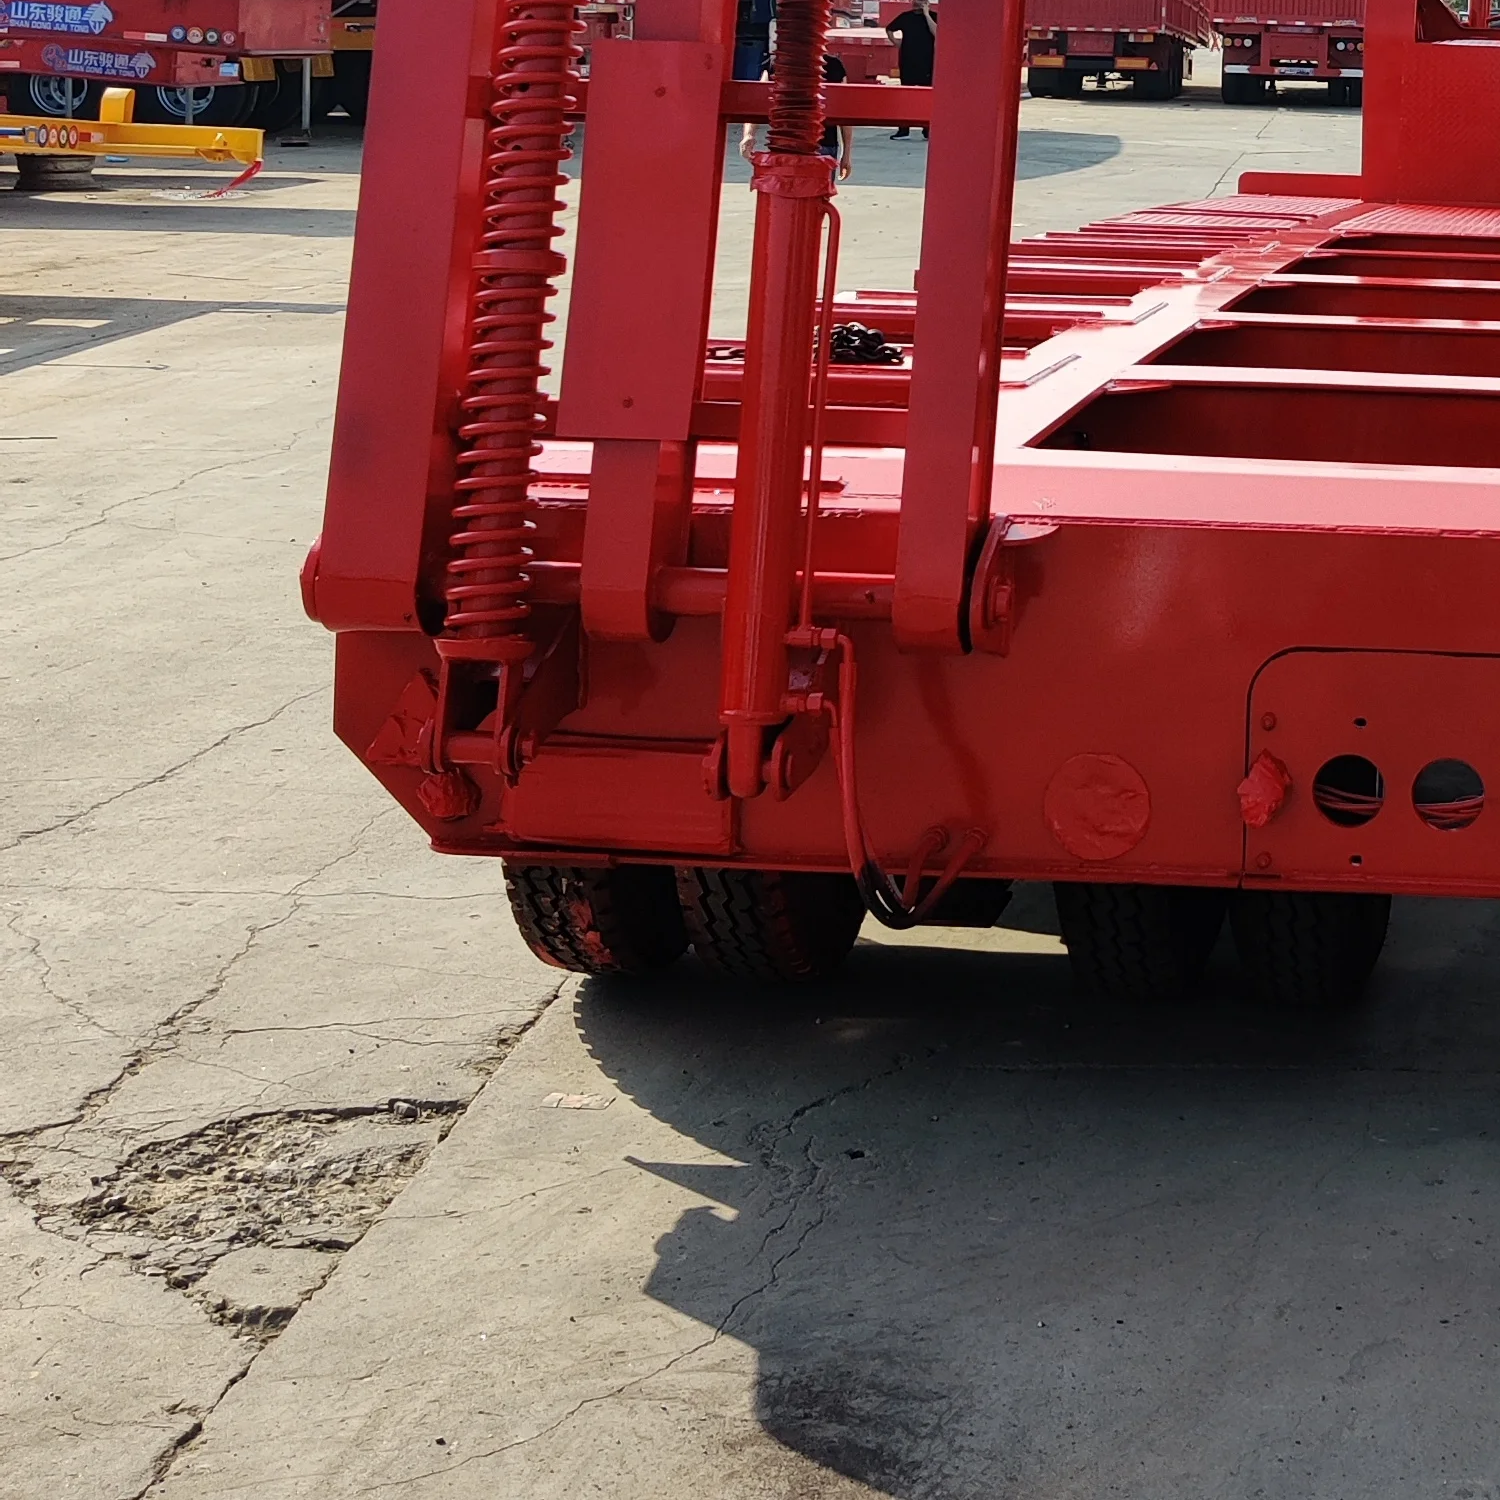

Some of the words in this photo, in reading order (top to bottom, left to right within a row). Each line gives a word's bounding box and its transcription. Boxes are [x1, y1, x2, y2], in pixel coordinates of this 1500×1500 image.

[10, 1, 82, 24] 山东骏通
[9, 20, 30, 28] SHAN
[31, 21, 52, 30] DONG
[53, 23, 68, 32] JUN
[70, 24, 90, 33] TONG
[68, 48, 130, 69] 山东骏通
